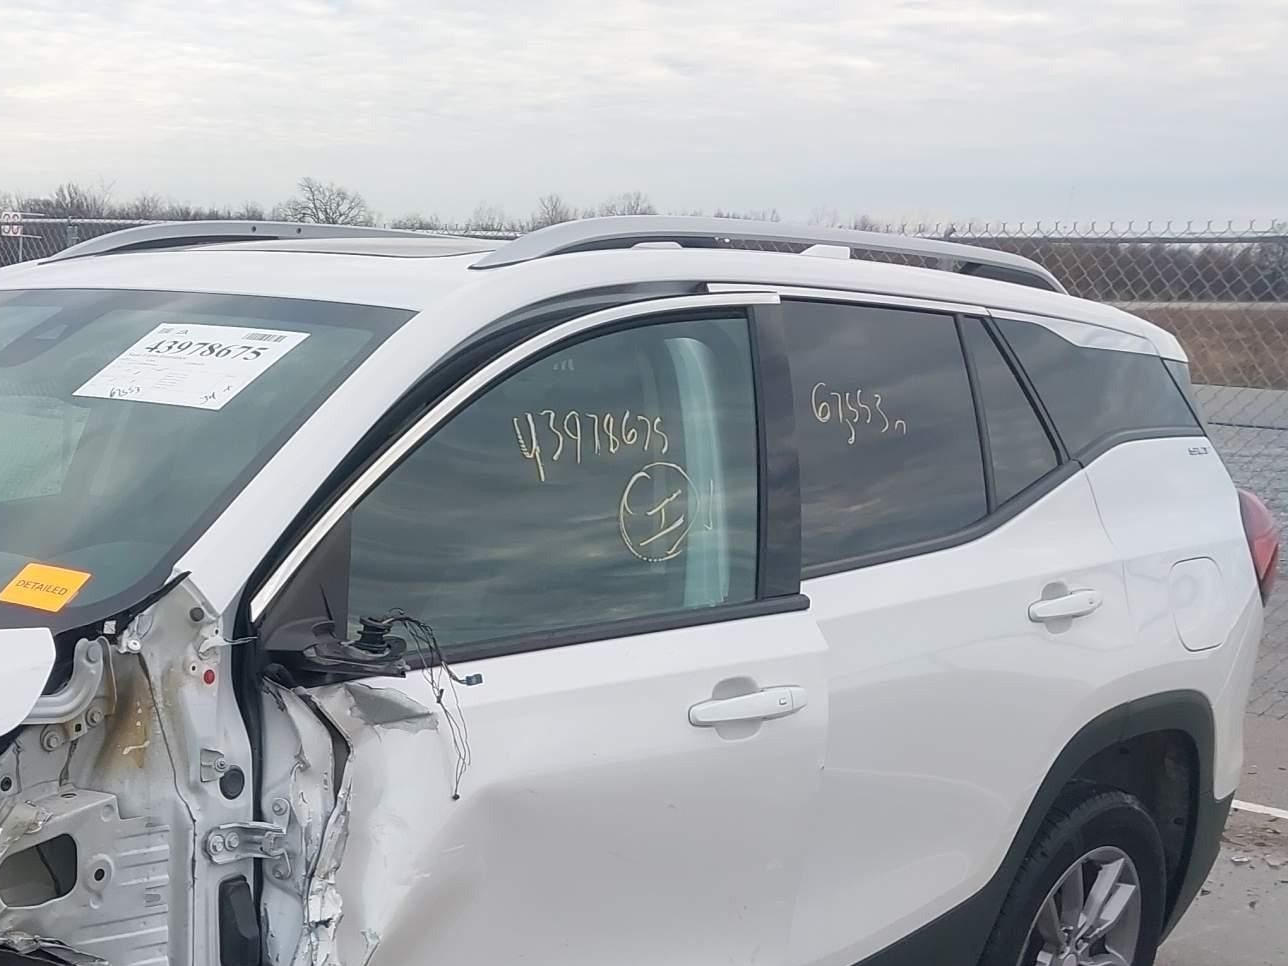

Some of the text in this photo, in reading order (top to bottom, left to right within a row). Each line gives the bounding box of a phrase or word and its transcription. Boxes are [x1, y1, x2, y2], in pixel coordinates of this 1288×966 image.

[144, 339, 269, 361] 43978675
[513, 409, 668, 482] 43978675
[16, 579, 69, 596] DETAILED
